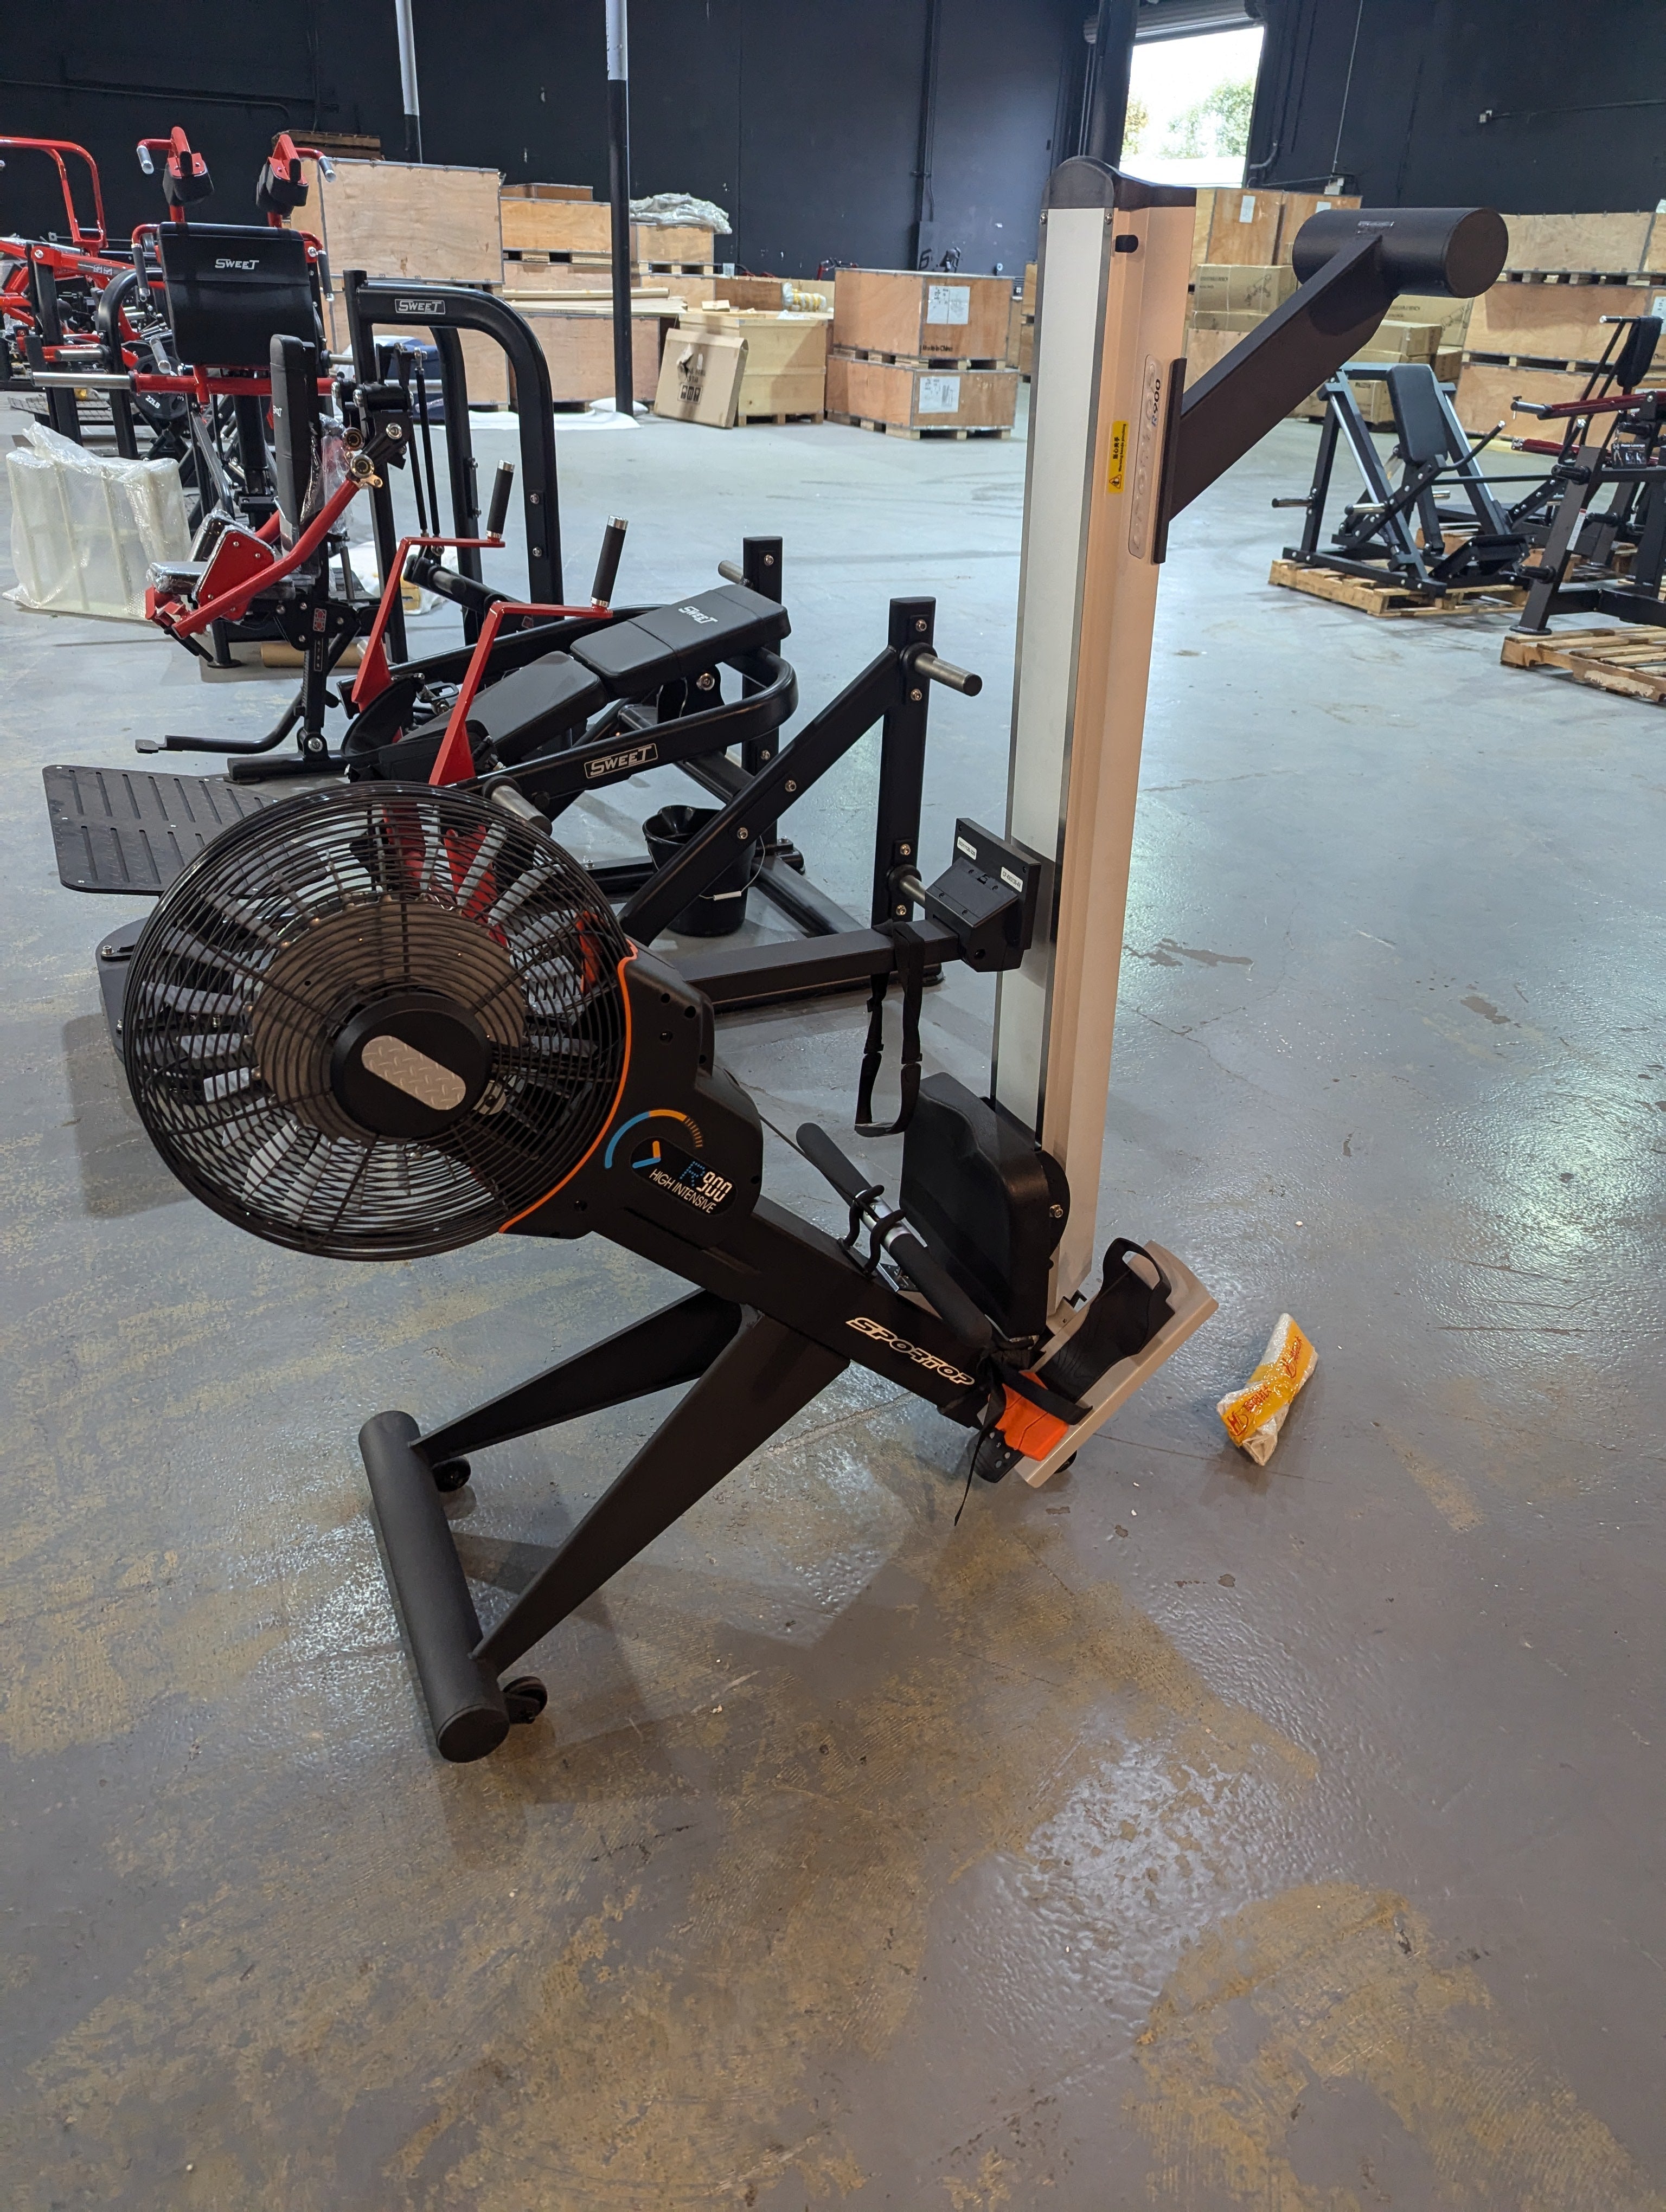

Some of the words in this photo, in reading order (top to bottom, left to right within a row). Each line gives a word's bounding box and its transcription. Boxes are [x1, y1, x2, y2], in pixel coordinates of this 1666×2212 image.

[215, 258, 260, 270] SWEET
[398, 300, 442, 313] SWEET
[145, 395, 161, 409] 22LB
[1151, 378, 1161, 427] R900
[678, 606, 719, 623] SWEET
[589, 745, 652, 776] SWEET
[649, 1168, 676, 1189] HIGH
[671, 1182, 717, 1214] INTENSIVE
[845, 1317, 975, 1385] SPORTOP
